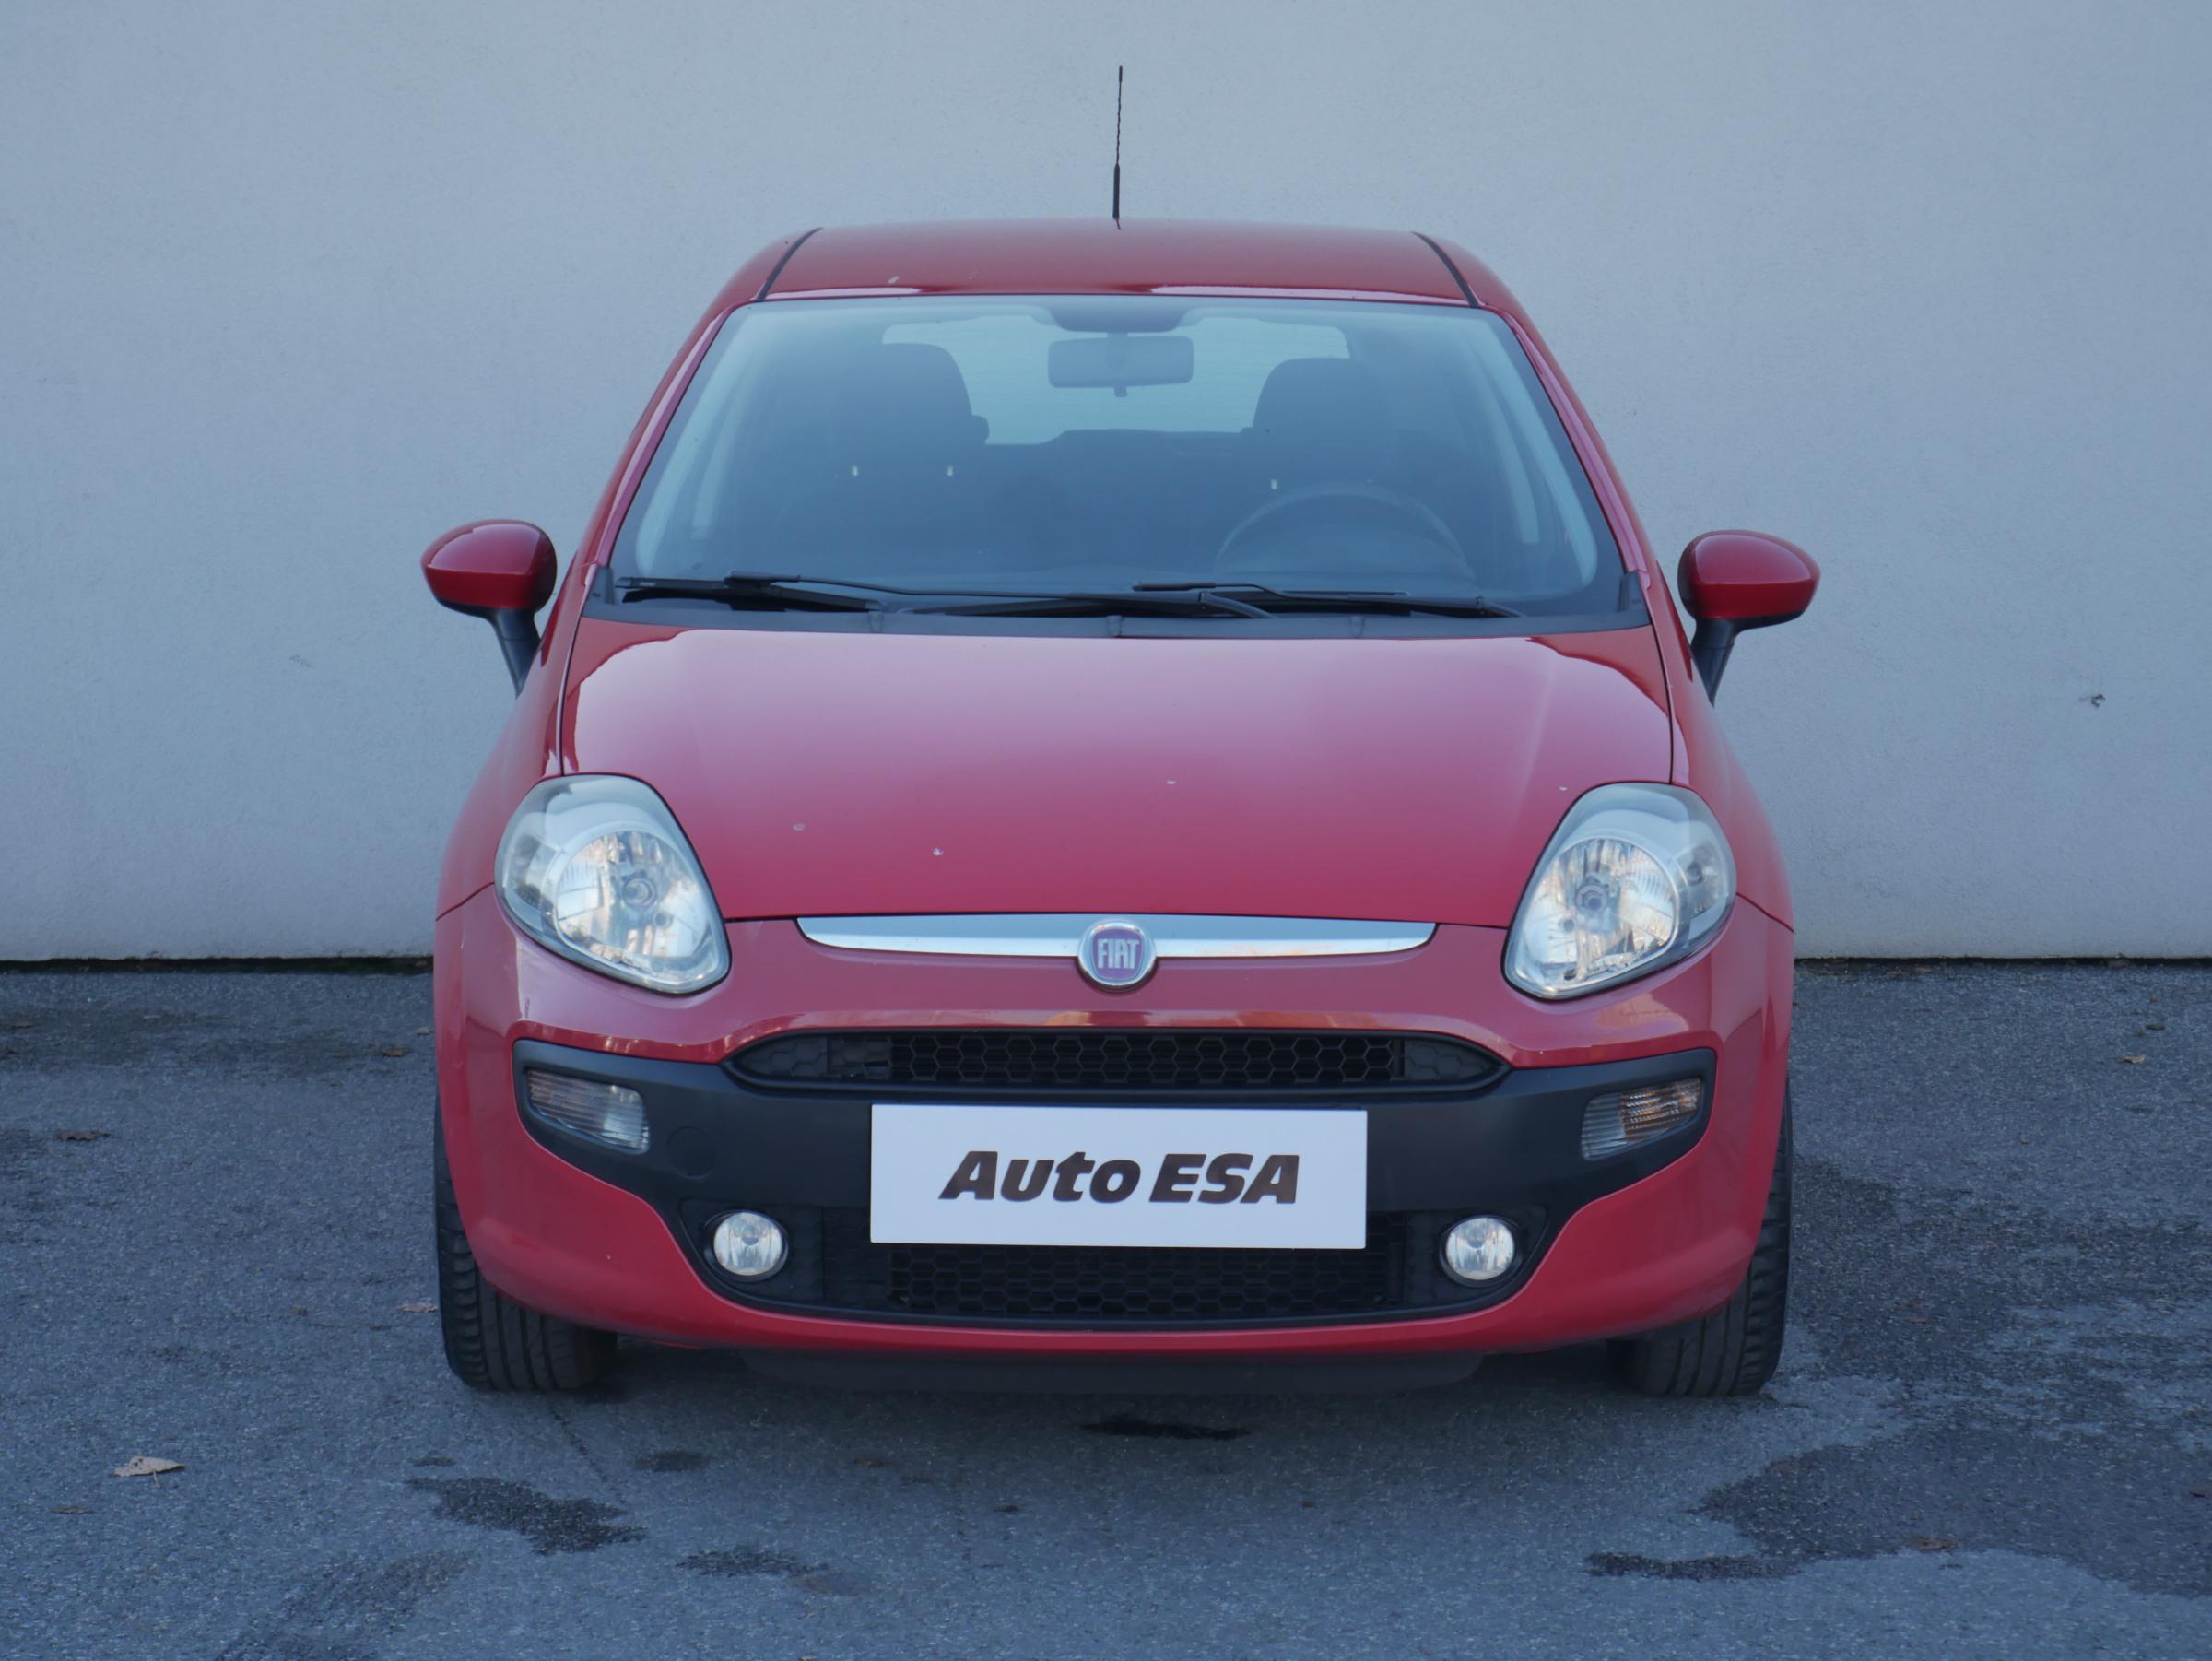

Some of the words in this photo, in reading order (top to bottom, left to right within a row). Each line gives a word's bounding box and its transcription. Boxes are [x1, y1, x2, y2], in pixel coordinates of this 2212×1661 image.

[1097, 938, 1140, 969] FIAT
[938, 1150, 1141, 1203] Auto
[1149, 1152, 1300, 1204] ESA
